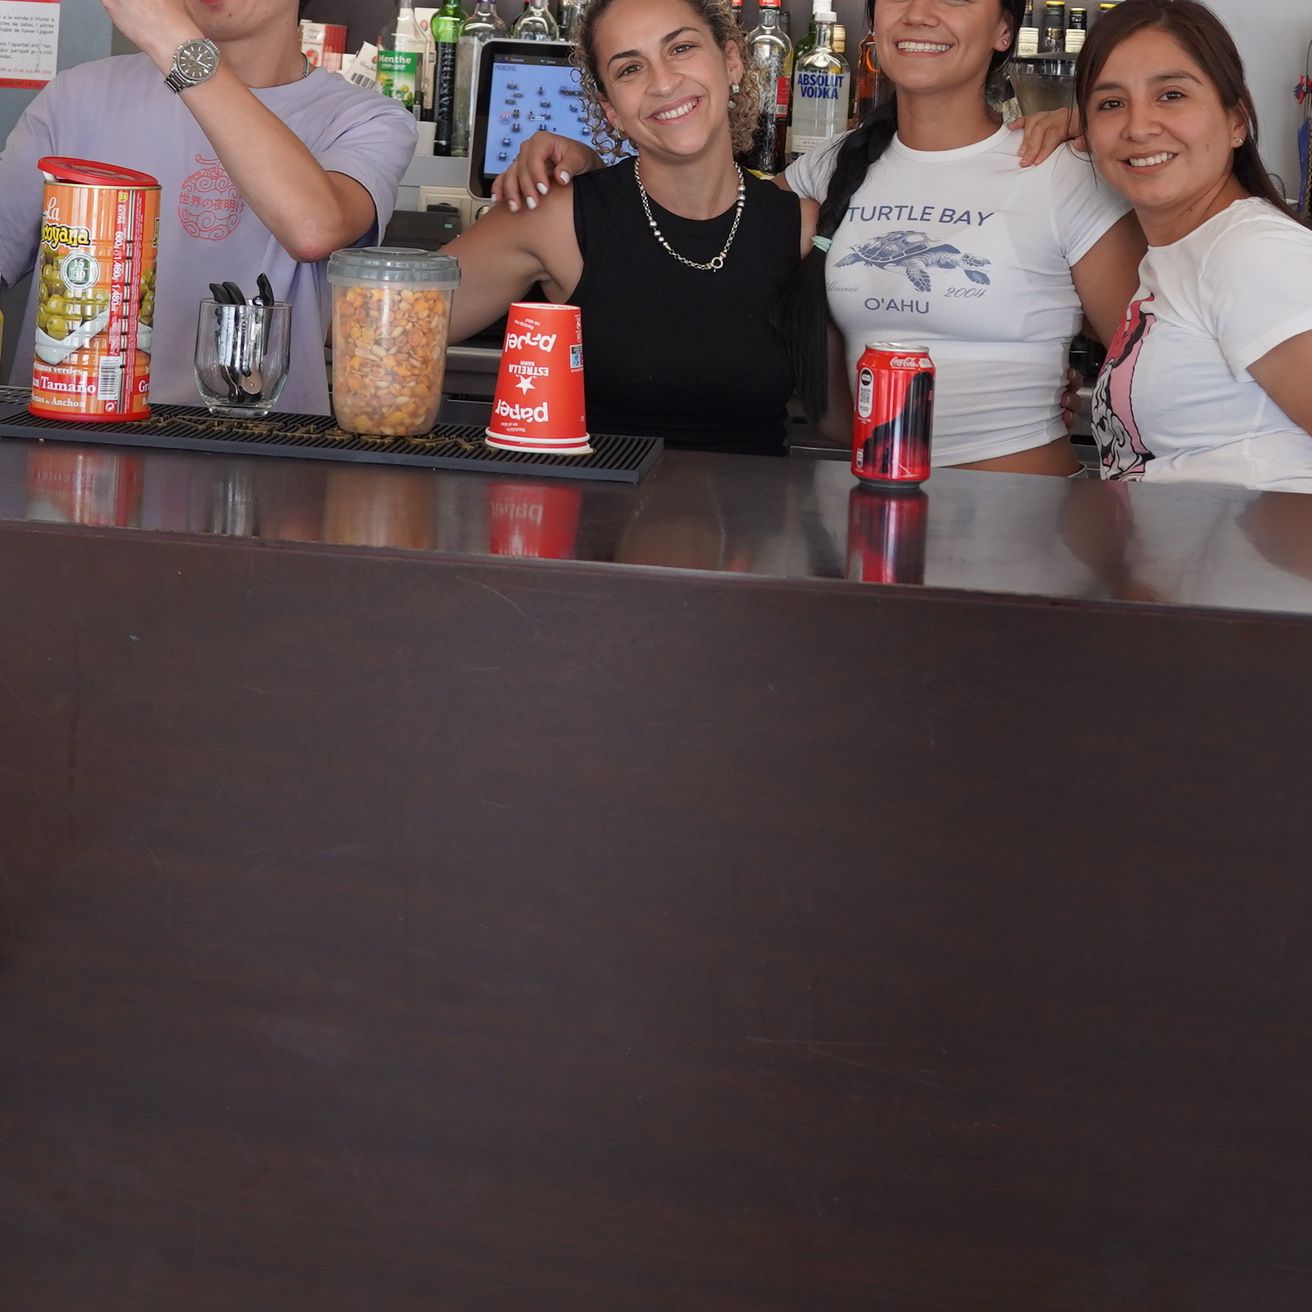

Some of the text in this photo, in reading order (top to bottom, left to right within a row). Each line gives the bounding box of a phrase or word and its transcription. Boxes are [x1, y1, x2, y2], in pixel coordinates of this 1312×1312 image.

[798, 74, 844, 88] ABSOLUT
[800, 86, 839, 99] VODKA
[178, 191, 244, 213] 世界の夜明け
[848, 205, 995, 227] TURTLE BAY
[944, 286, 988, 298] 2004
[864, 297, 930, 314] O'AHU
[508, 363, 549, 376] ESTRELLA
[41, 376, 96, 394] Tamaño
